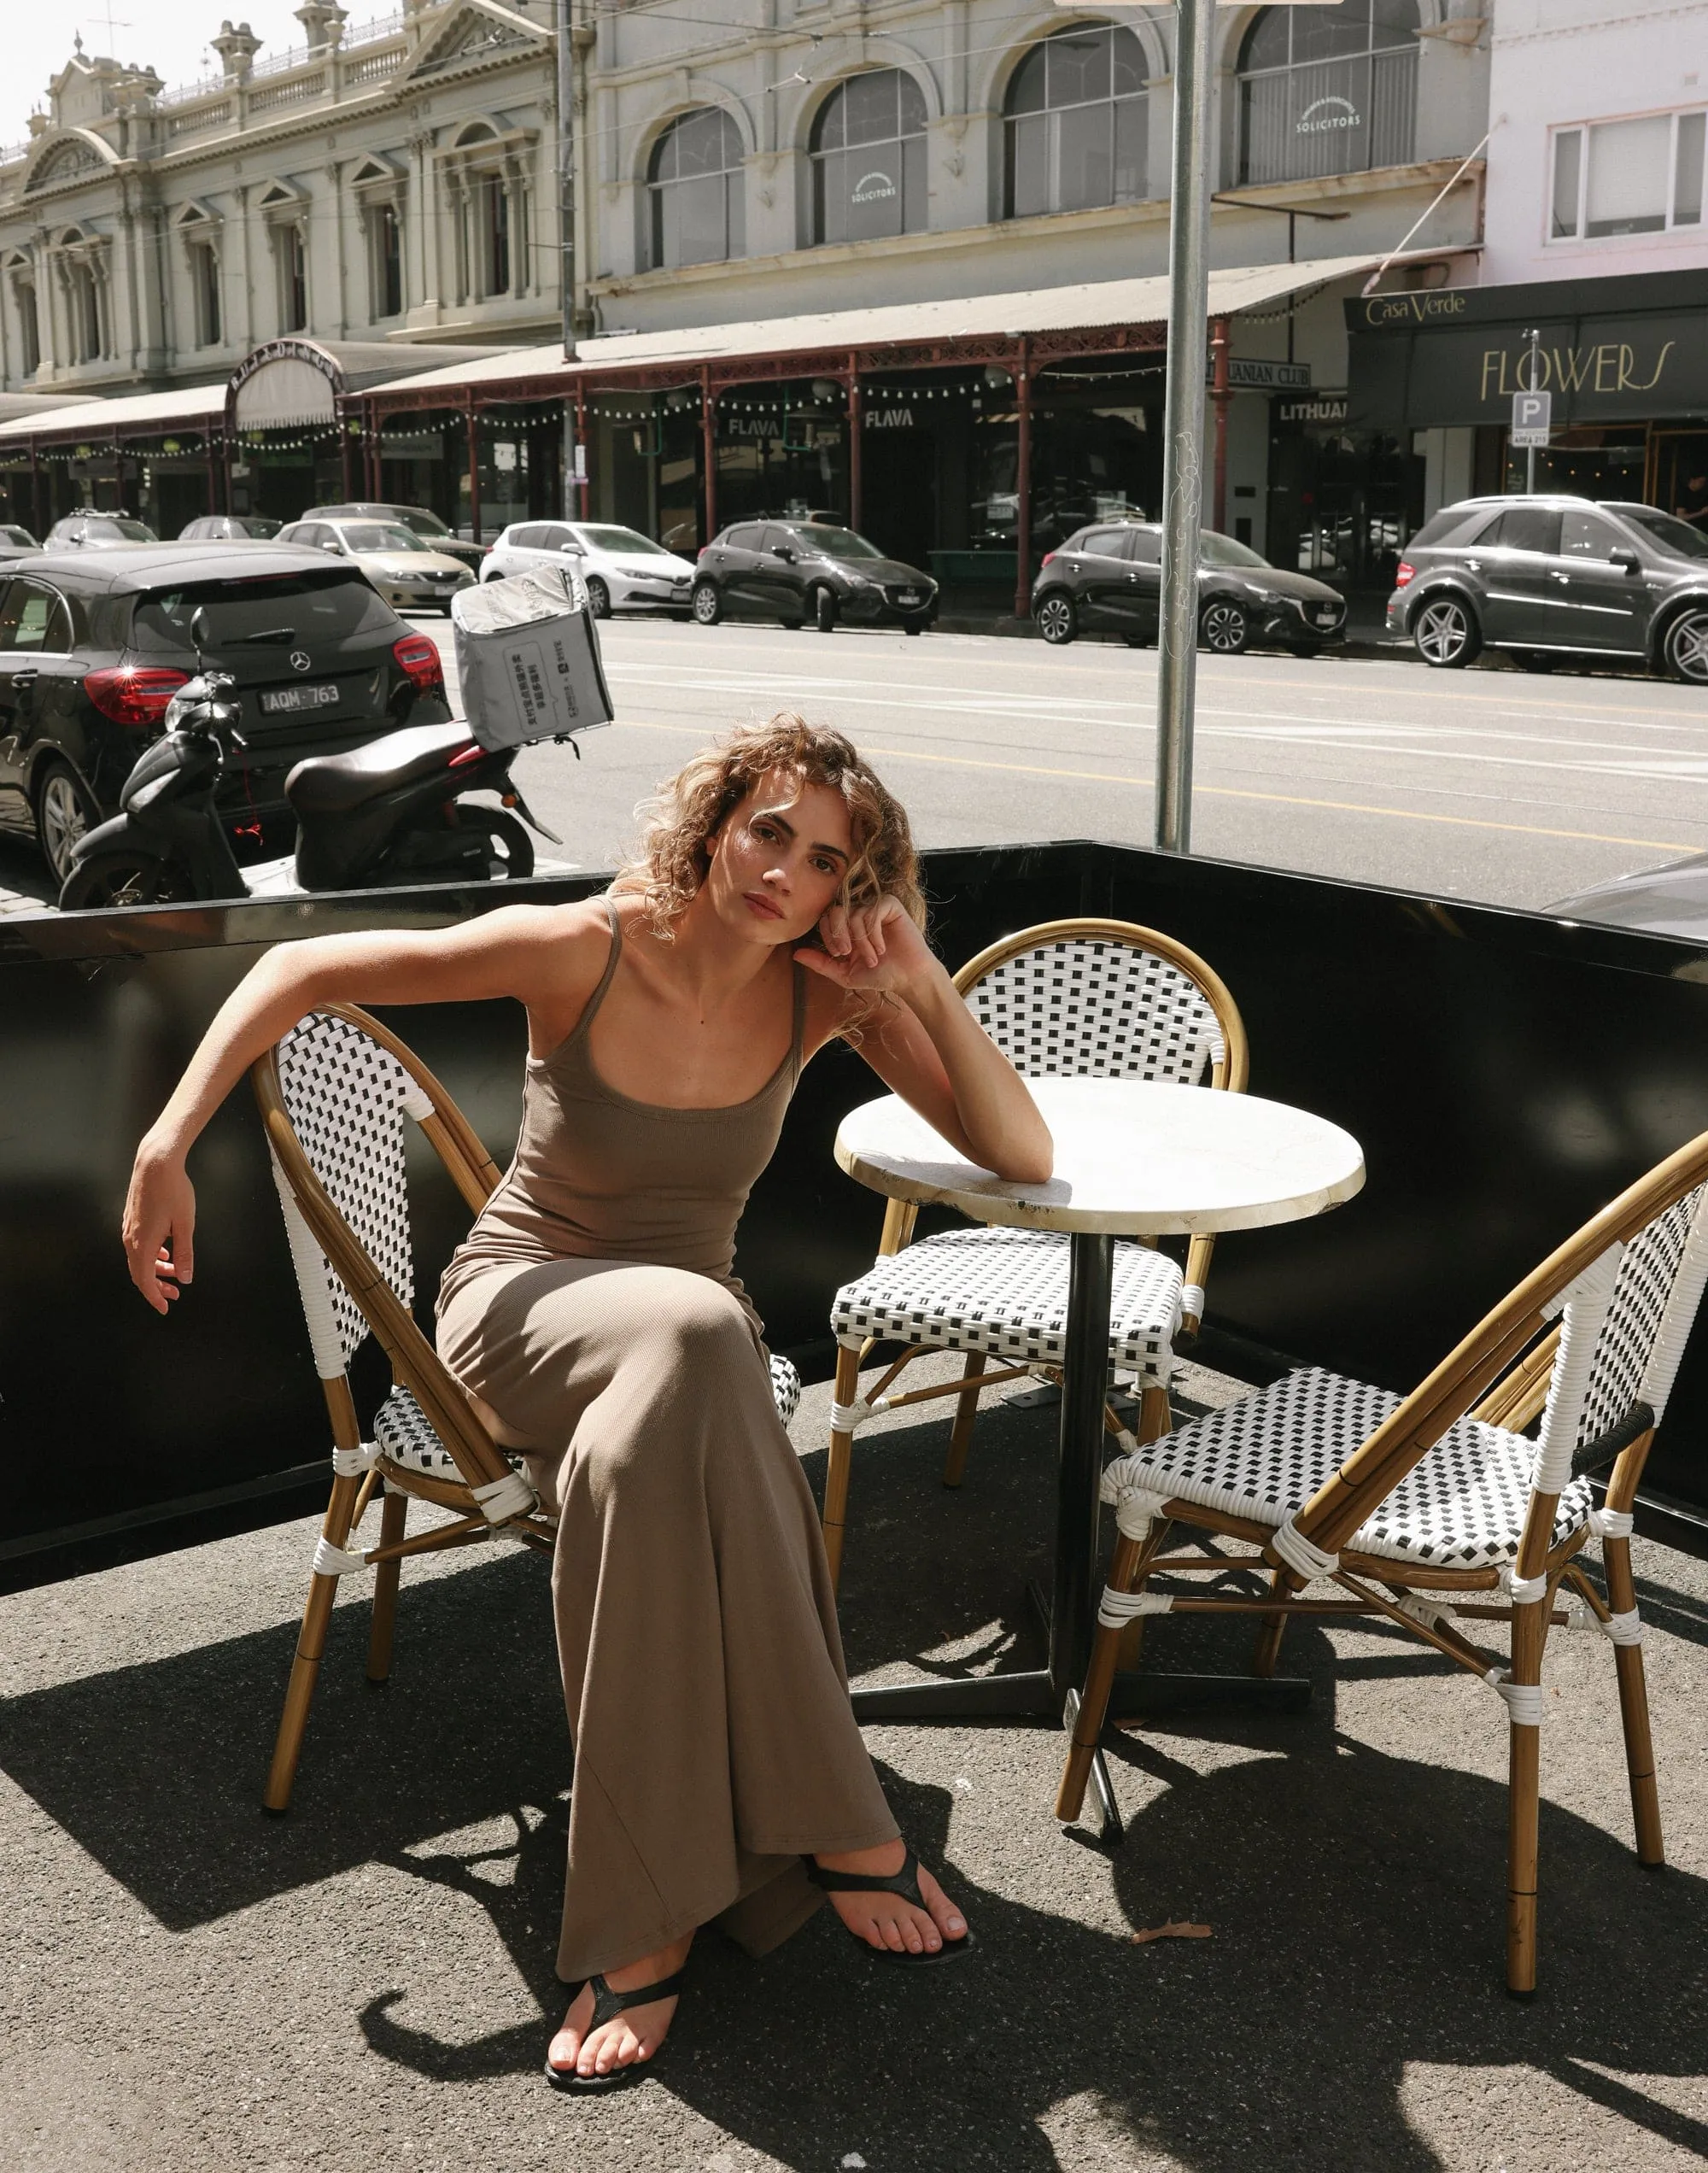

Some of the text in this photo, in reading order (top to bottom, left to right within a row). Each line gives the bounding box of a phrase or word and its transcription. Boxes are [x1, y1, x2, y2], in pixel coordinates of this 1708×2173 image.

[1296, 114, 1360, 133] SOLICITORS
[851, 186, 896, 203] SOLICITORS
[1366, 293, 1465, 325] Casa Verde
[1278, 368, 1309, 384] CLUB
[1481, 341, 1676, 401] FLOWERS
[865, 408, 913, 428] FLAVA
[1522, 399, 1541, 425] P
[729, 419, 779, 436] FLAVA
